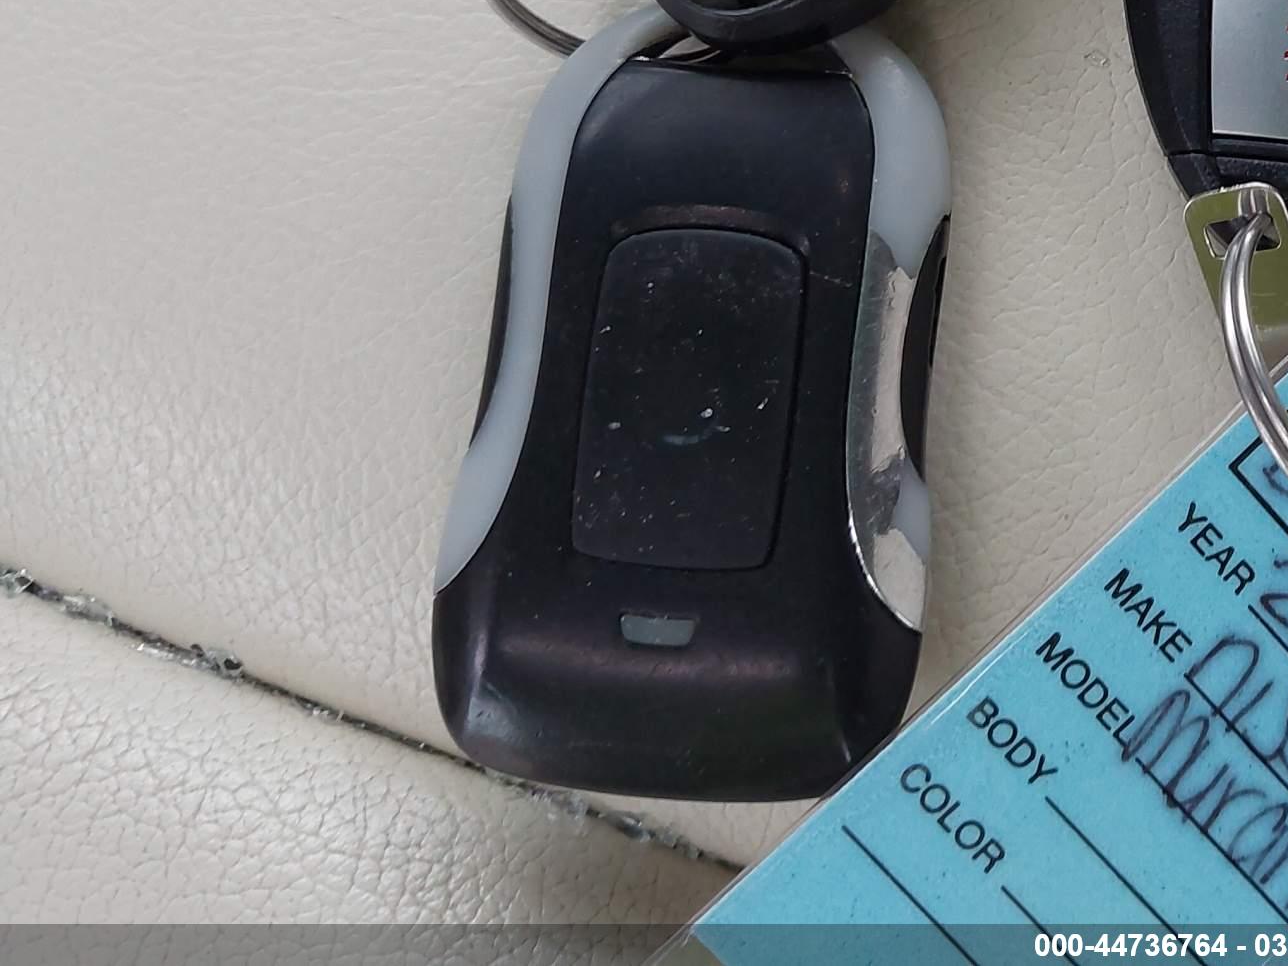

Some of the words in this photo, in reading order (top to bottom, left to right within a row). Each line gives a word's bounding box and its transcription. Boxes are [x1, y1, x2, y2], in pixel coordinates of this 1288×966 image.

[1178, 501, 1256, 597] YEAR
[1103, 568, 1193, 663] MAKE
[1036, 632, 1137, 748] MODEL
[966, 697, 1060, 786] BODY
[900, 763, 1006, 874] COLOR
